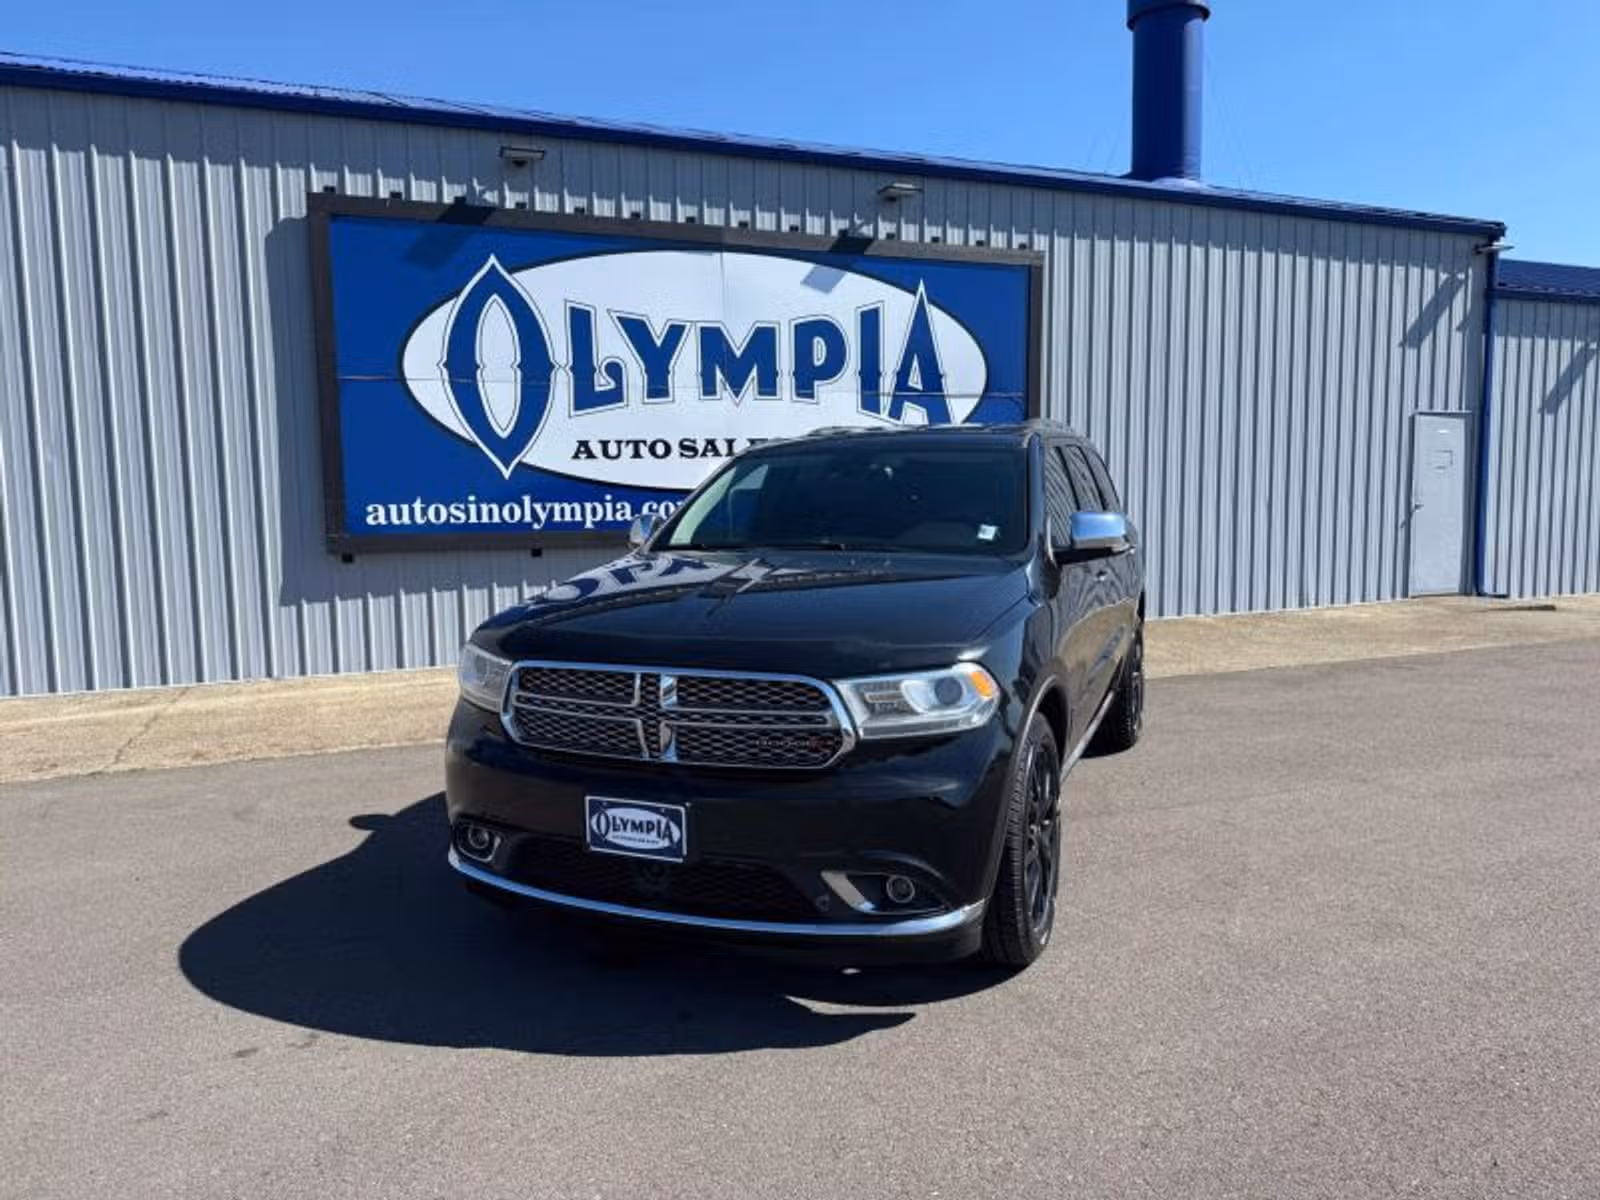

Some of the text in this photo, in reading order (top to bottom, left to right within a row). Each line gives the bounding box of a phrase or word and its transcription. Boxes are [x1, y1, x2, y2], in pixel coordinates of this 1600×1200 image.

[438, 254, 954, 478] OLYMPIA
[572, 438, 769, 460] AUTO SAL
[365, 495, 683, 529] autosinolympia.co
[596, 809, 674, 844] OLYMPIA
